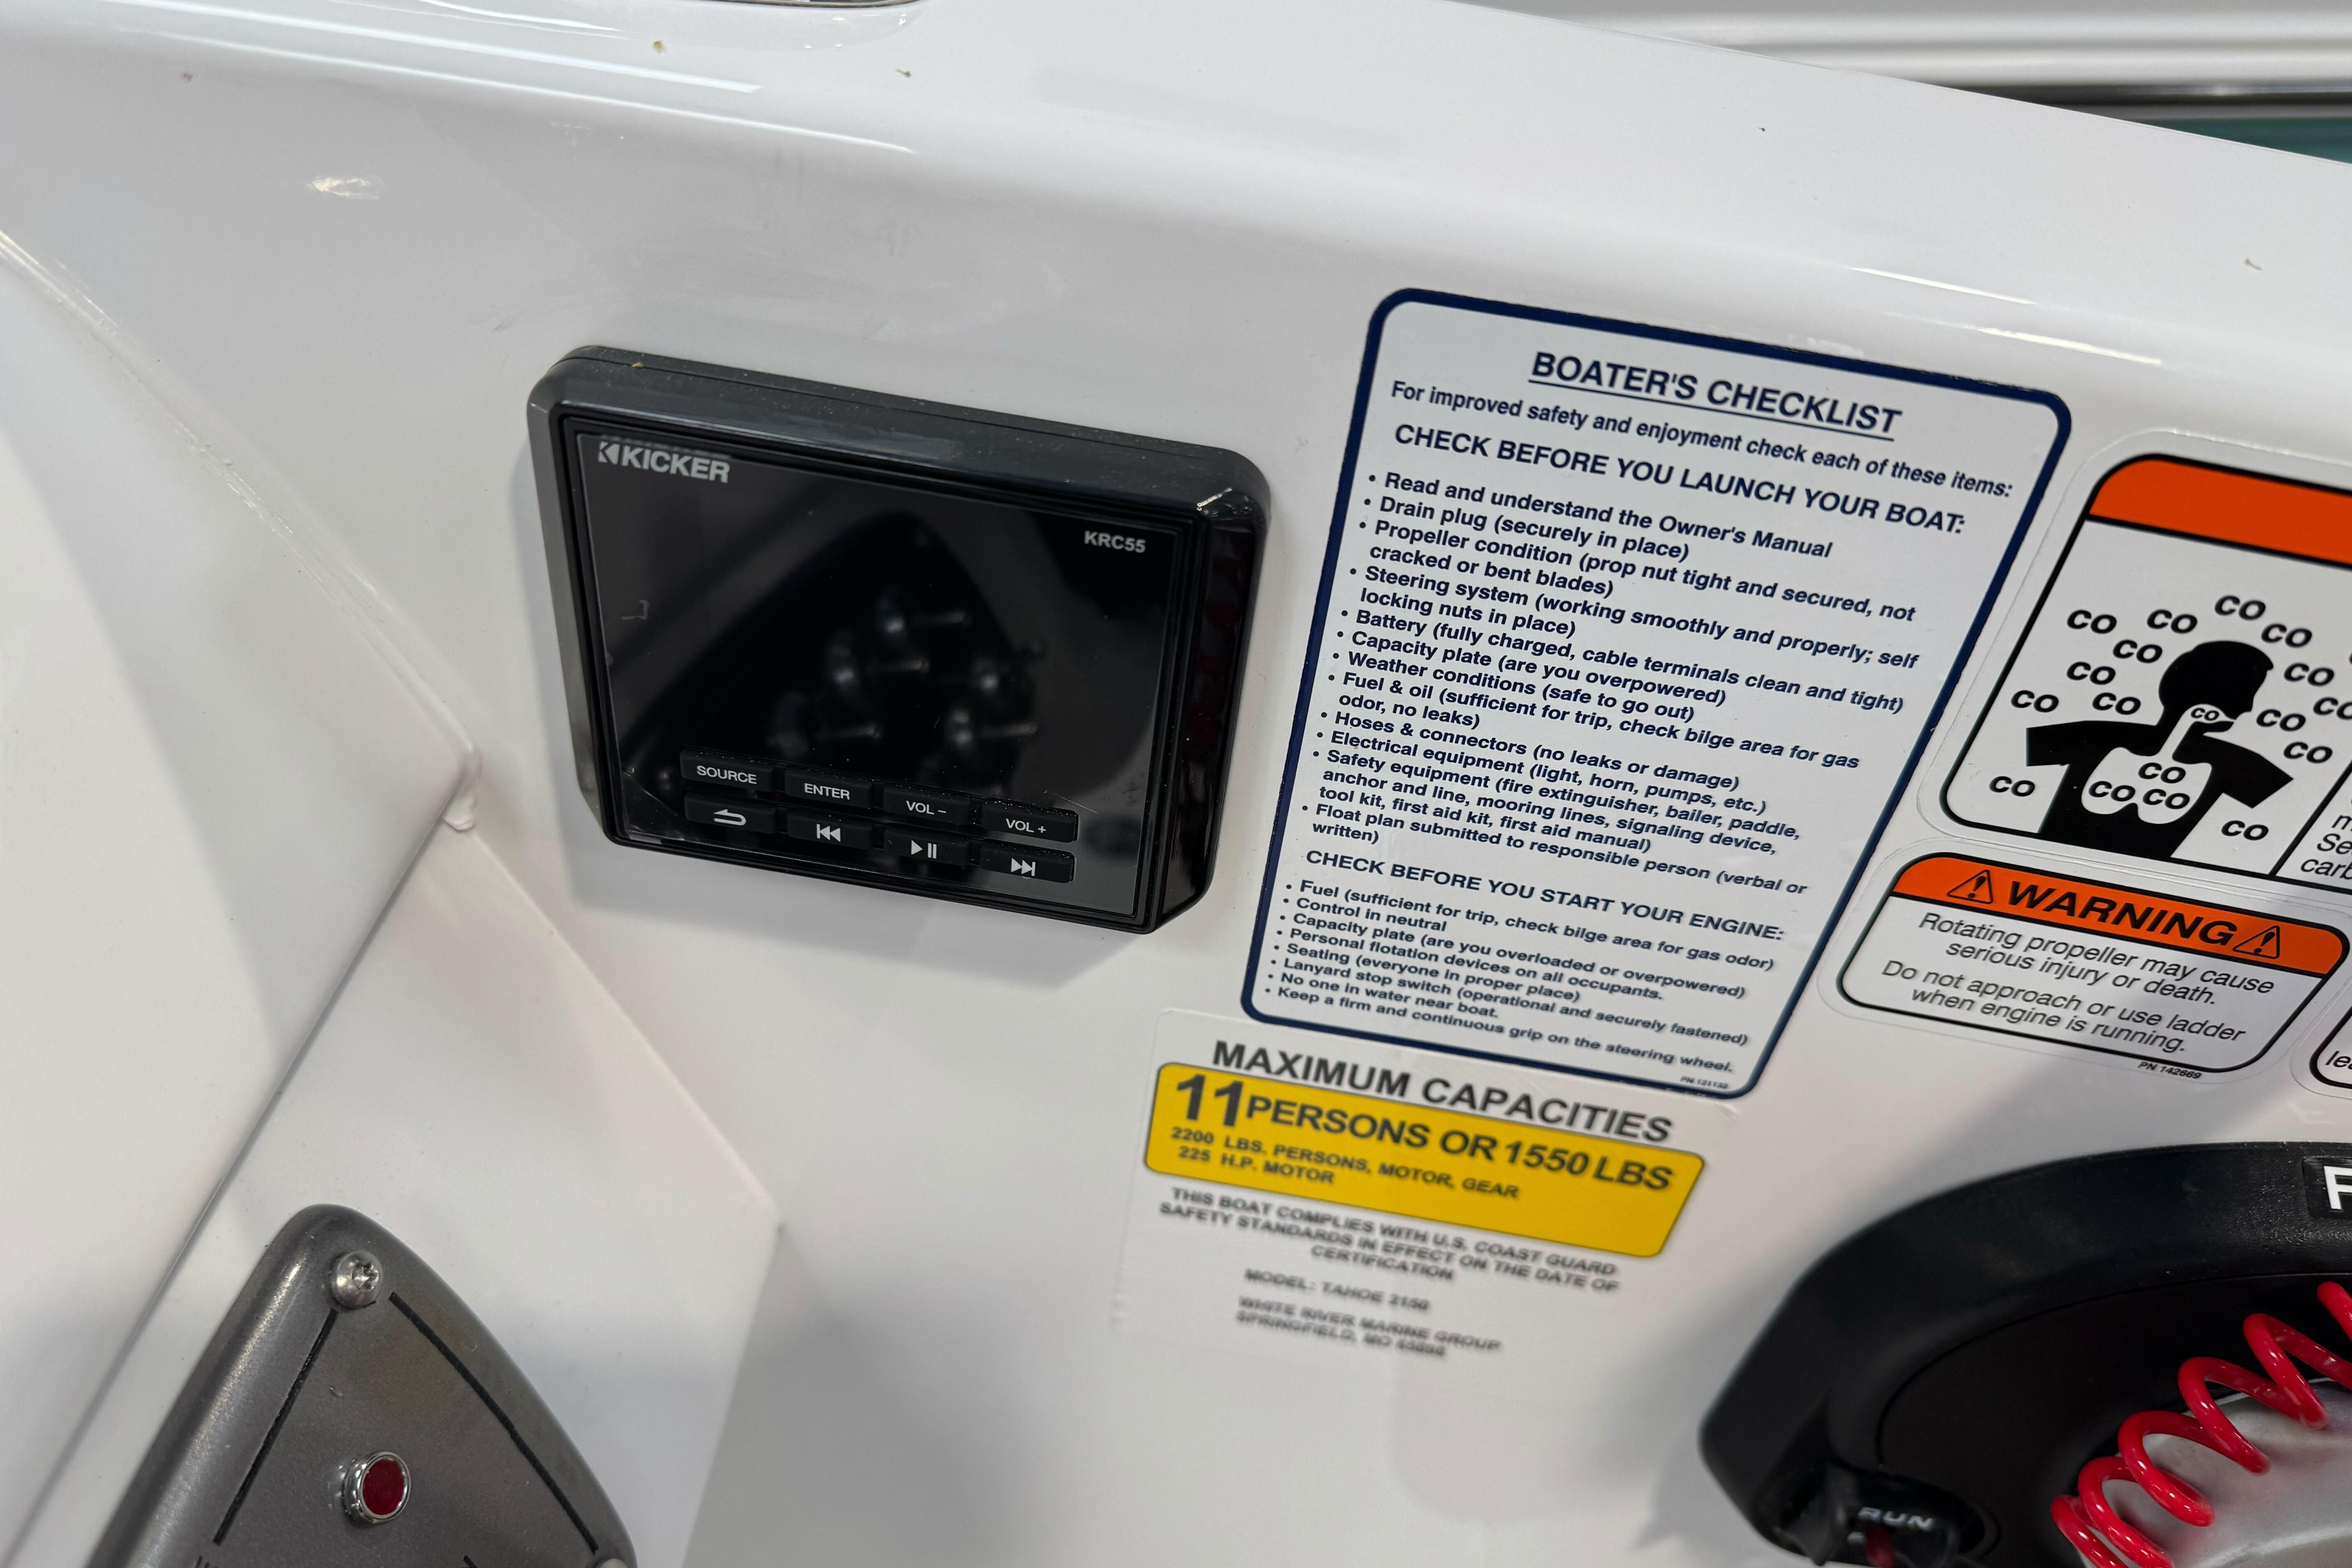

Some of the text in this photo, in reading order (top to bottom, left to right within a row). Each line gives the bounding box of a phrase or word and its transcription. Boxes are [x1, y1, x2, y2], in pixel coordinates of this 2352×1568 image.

[1531, 351, 1903, 434] BOATER'S CHECKLIST
[1391, 380, 2013, 497] For improved safety and enjoyment check each of these items:
[621, 445, 730, 483] KICKER
[1395, 424, 1965, 534] CHECK BEFORE YOU LAUNCH YOUR BOAT:
[1379, 495, 1689, 563] Drain plug (securely in place)
[1384, 471, 1833, 558] Read and understand the Owner's Manual
[1084, 530, 1146, 553] KRC55
[1374, 519, 1916, 622] Propeller condition (prop nut tight and secured, not
[2067, 609, 2117, 634] CO
[2147, 609, 2198, 634] CO
[2214, 595, 2266, 621] CO
[2261, 623, 2312, 648] CO
[2113, 639, 2163, 664] CO
[2067, 661, 2116, 685] CO
[2284, 663, 2335, 686] CO
[2011, 690, 2059, 713] CO
[2092, 692, 2141, 715] CO
[2191, 706, 2221, 721] CO
[2256, 709, 2306, 732] CO
[1335, 711, 1739, 792] Hoses & connectors (no leaks or damage)
[2283, 742, 2333, 764] CO
[696, 765, 757, 784] SOURCE
[1989, 776, 2035, 797] CO
[2138, 761, 2187, 784] CO
[804, 783, 850, 800] ENTER
[1327, 749, 1800, 841] Safety equipment (fire extinguisher, bailer, paddle,
[2088, 781, 2136, 802] CO
[2142, 789, 2190, 810] CO
[906, 800, 935, 815] VOL
[1006, 818, 1035, 833] VOL
[2221, 820, 2269, 841] CO
[2317, 833, 2352, 855] Se
[1306, 850, 1784, 940] CHECK BEFORE YOU START YOUR ENGINE:
[1296, 897, 1447, 932] Control in neutral
[2009, 880, 2238, 946] WARNING
[1918, 912, 2275, 994] Rotating propeller may cause
[1945, 943, 2215, 1005] serious injury or death.
[1280, 972, 1498, 1018] No one in water near boat.
[1881, 959, 2247, 1041] Do not approach or use ladder
[1911, 989, 2185, 1054] when engine is running.
[2137, 1061, 2158, 1071] PN
[1213, 1040, 1672, 1142] MAXIMUM CAPACITIES
[1177, 1074, 1673, 1190] 11 PERSONS OR 1550 LBS
[1171, 1126, 1520, 1199] 2200 LBS. PERSONS, MOTOR, GEAR
[1178, 1146, 1335, 1184] 225 H.P. MOTOR
[1172, 1187, 1617, 1276] THIS BOAT COMPLIES WITH U.S. COAST GUARD
[1159, 1202, 1619, 1293] SAFETY STANDARDS IN EFFECT ON THE DATE OF
[1311, 1245, 1454, 1281] CERTIFICATION
